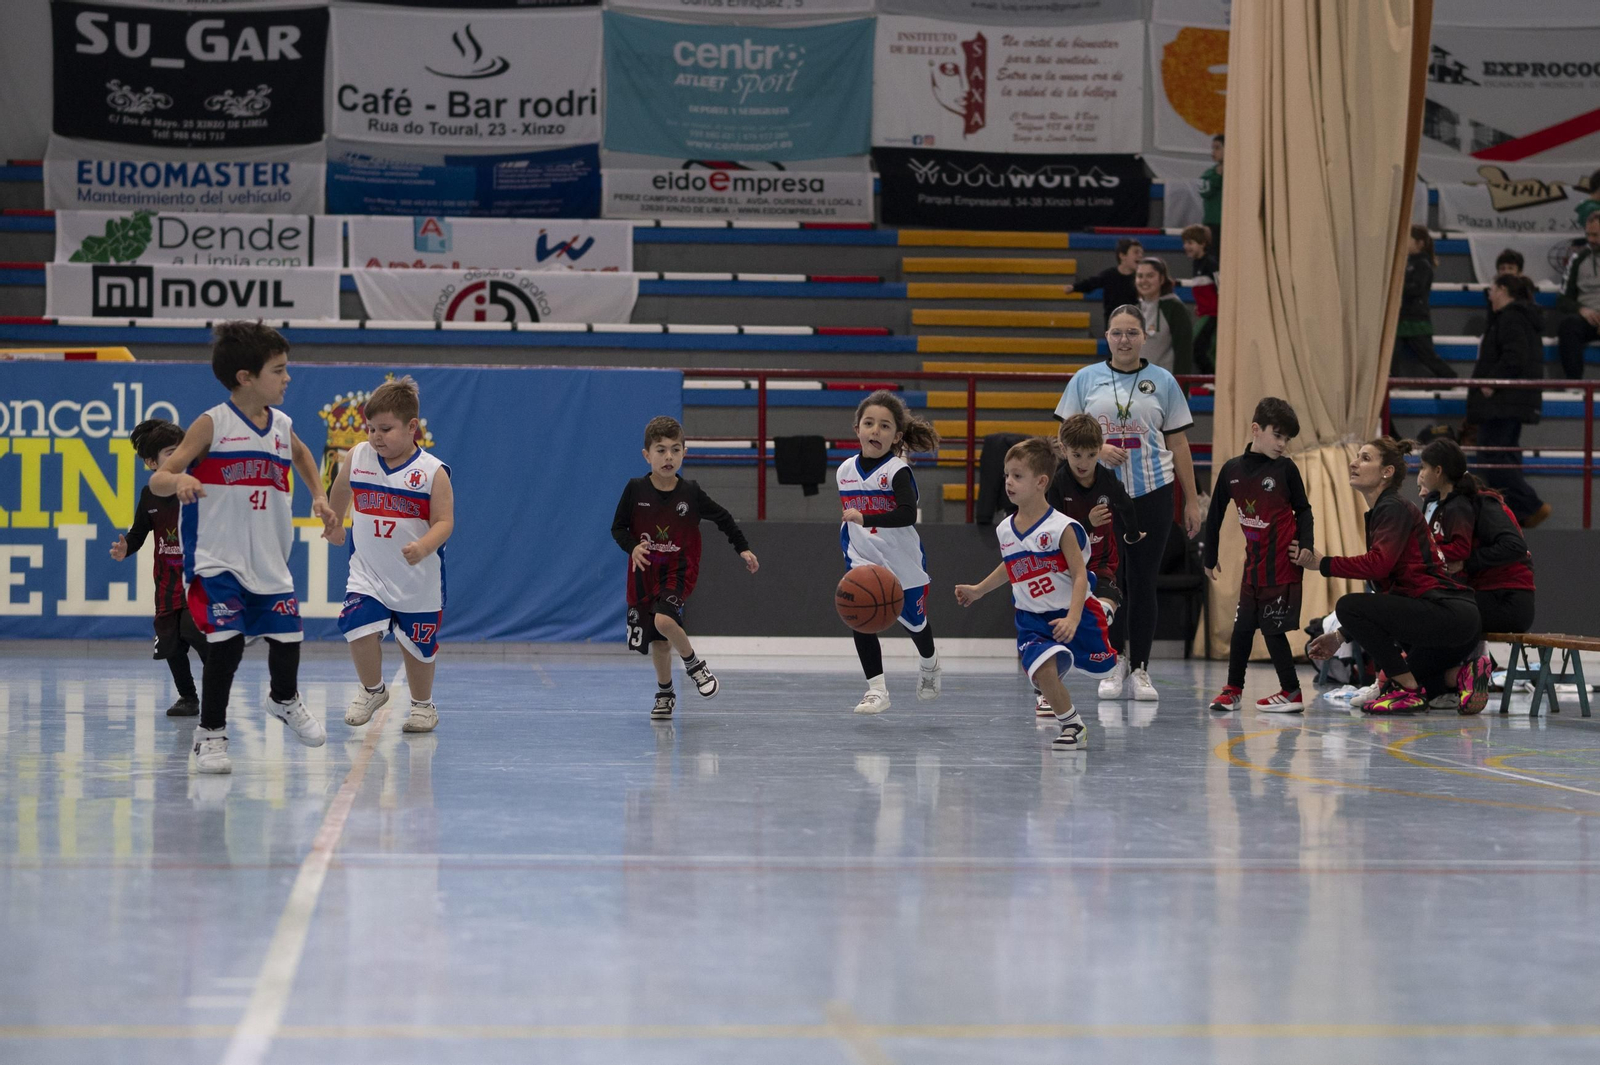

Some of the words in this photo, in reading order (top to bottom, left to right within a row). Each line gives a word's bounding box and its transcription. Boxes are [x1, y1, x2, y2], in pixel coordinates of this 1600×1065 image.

[898, 32, 957, 41] INSTITUTO
[890, 45, 903, 53] DE
[907, 46, 957, 55] BELLEZA
[338, 84, 412, 116] Café
[448, 91, 508, 118] Bar
[519, 88, 597, 118] rodri
[404, 120, 424, 135] do
[429, 122, 483, 138] Toural,
[488, 123, 507, 136] 23
[522, 122, 566, 136] Xinzo
[77, 160, 290, 188] EUROMASTER
[78, 189, 193, 205] Mantenimiento
[200, 189, 223, 204] del
[693, 205, 704, 213] DE
[1457, 214, 1493, 229] Plaza
[1548, 218, 1558, 231] 2
[159, 216, 302, 251] Dende
[249, 490, 267, 510] 41
[374, 519, 397, 539] 17
[1027, 576, 1056, 600] 22
[411, 622, 438, 643] 17
